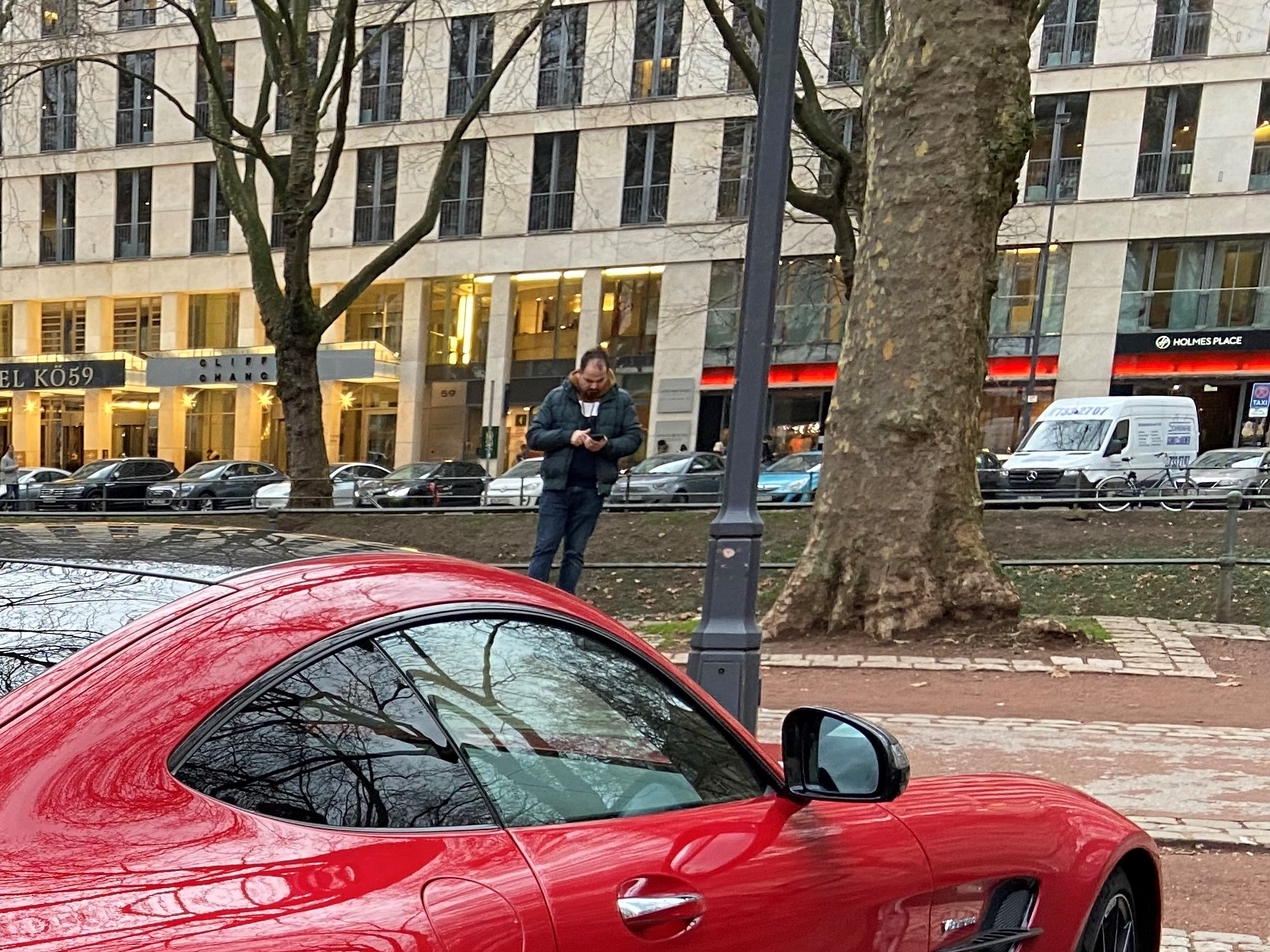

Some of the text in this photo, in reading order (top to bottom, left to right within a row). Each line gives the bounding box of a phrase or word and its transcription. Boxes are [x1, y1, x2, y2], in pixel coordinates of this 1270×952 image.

[1172, 336, 1243, 347] HOLMES PLACE
[199, 356, 268, 368] CLIFF
[34, 365, 94, 388] KÖ59
[199, 371, 269, 383] CHANG
[440, 389, 456, 398] 59
